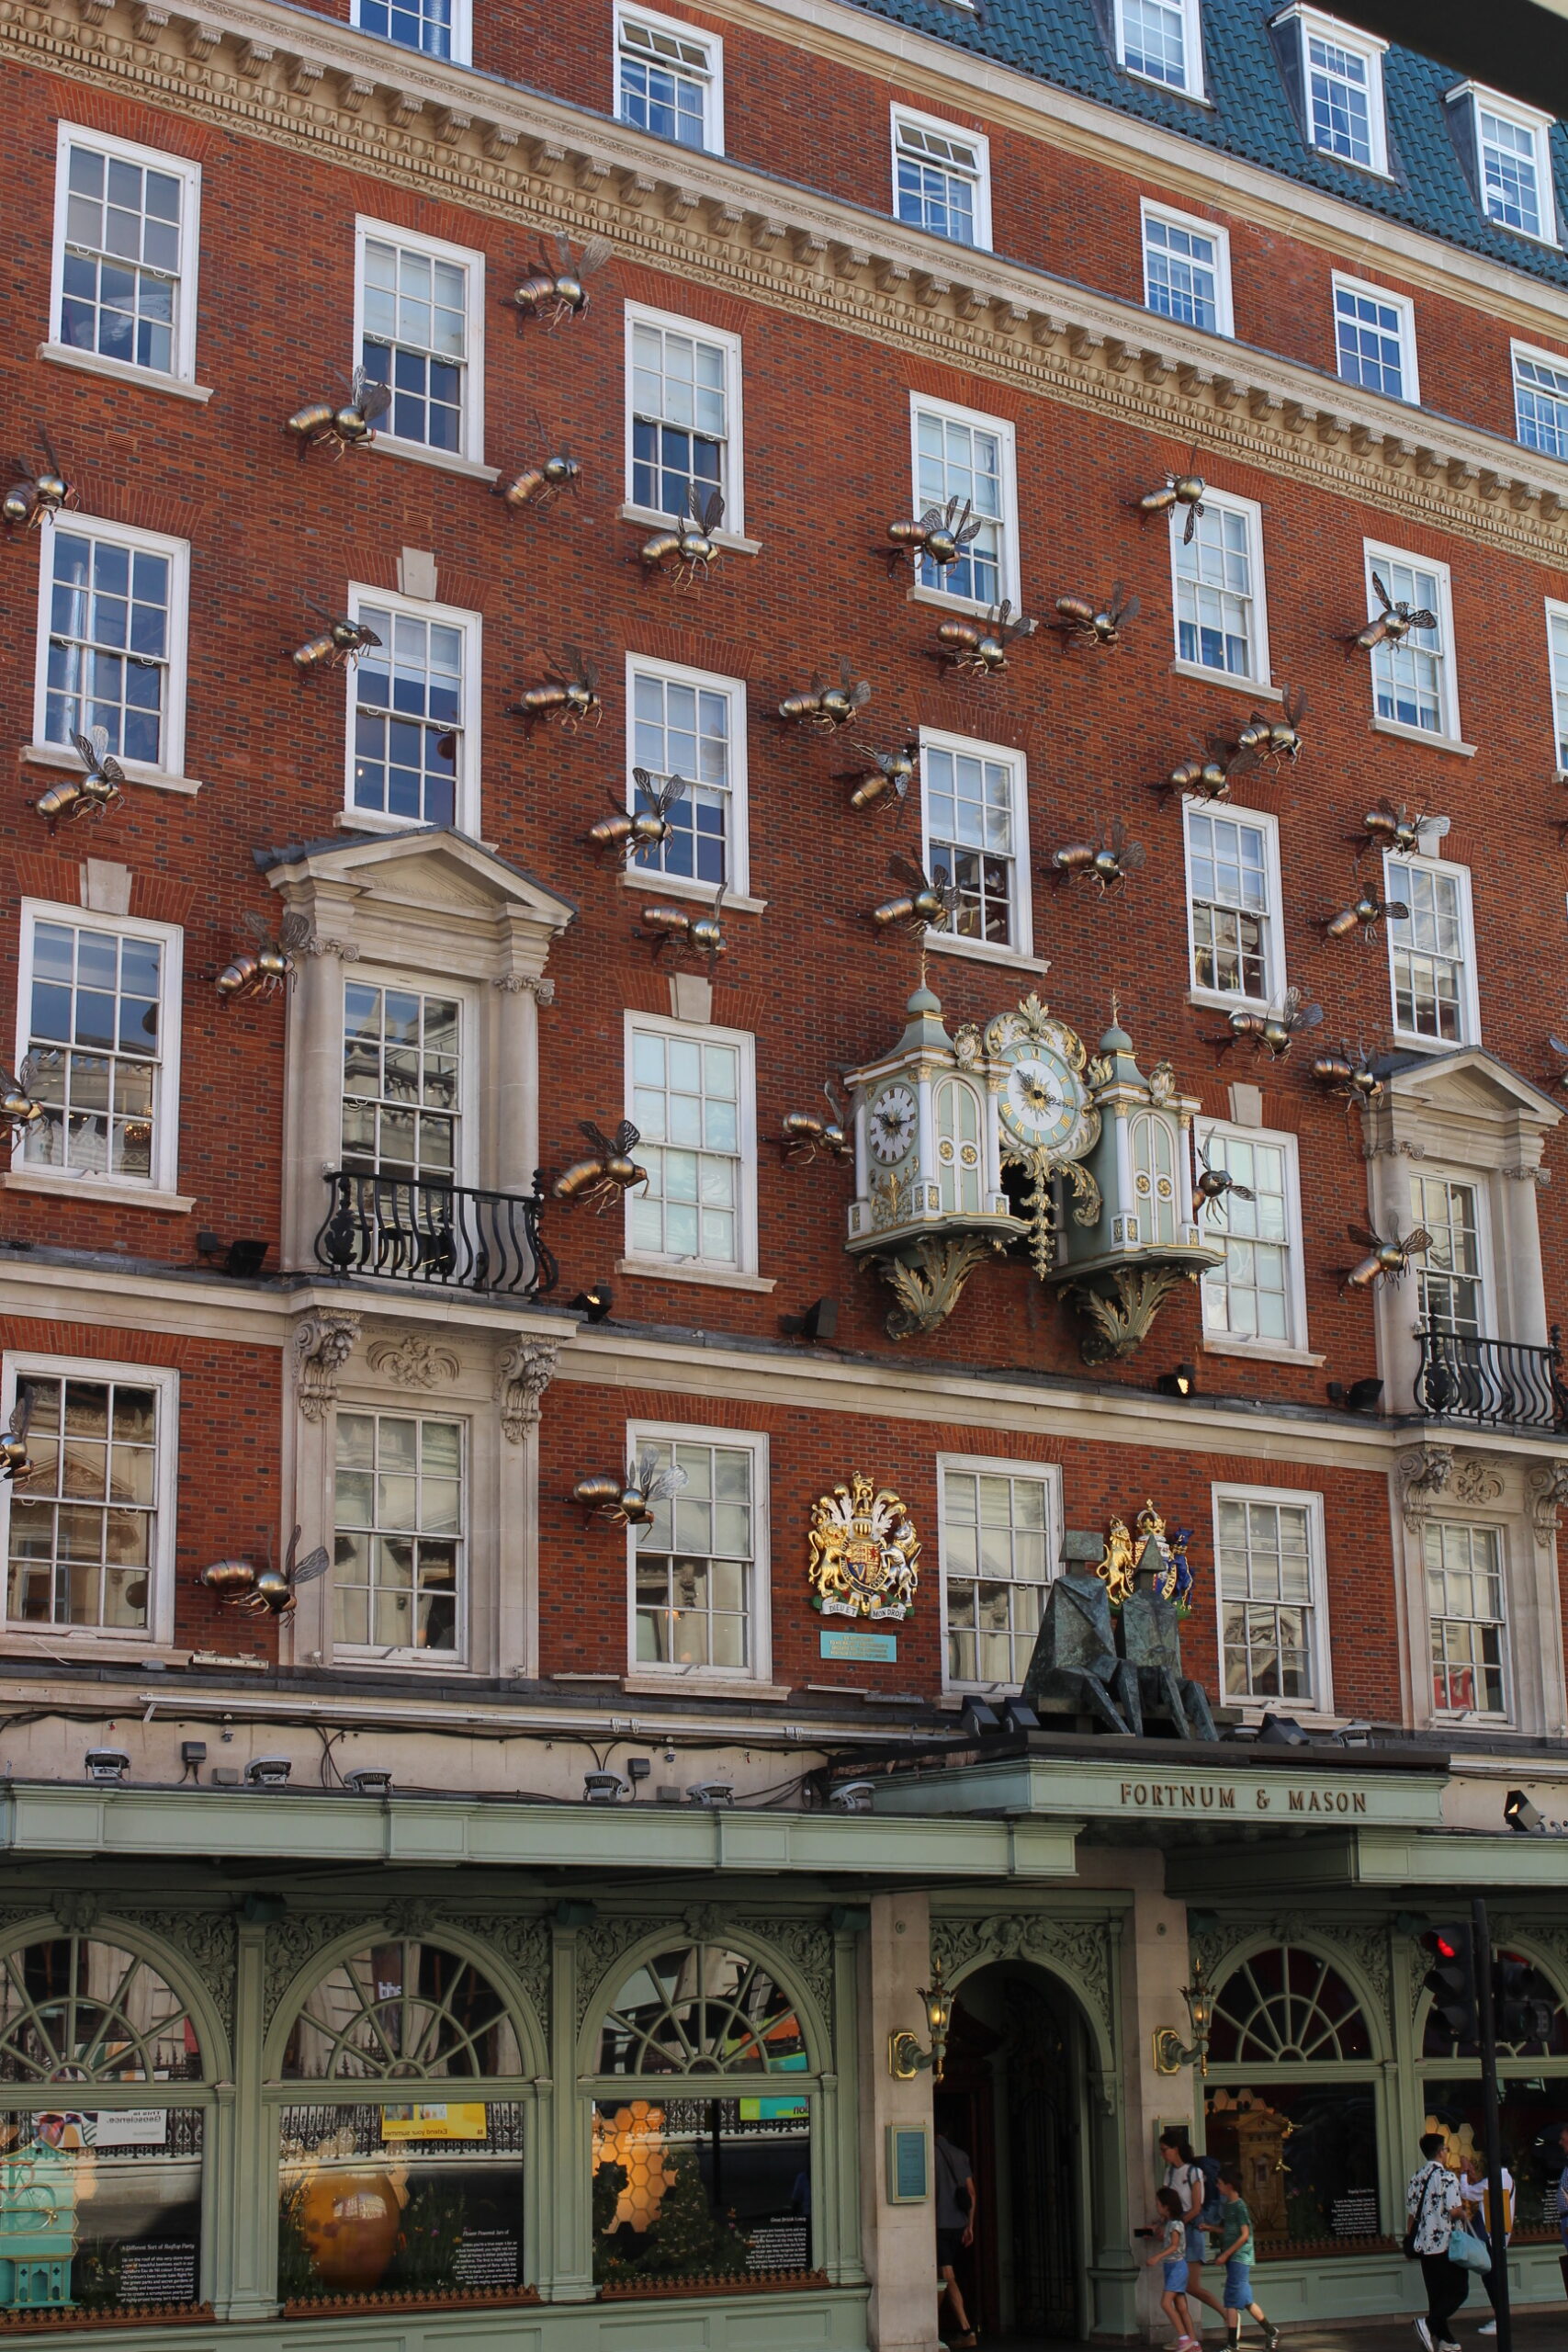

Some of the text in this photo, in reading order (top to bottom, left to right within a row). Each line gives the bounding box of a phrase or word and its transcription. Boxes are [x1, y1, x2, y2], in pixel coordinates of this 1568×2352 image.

[829, 1604, 857, 1616] DIEU ET
[873, 1610, 886, 1618] MON
[1121, 1783, 1366, 1813] FORTNUM & MASON
